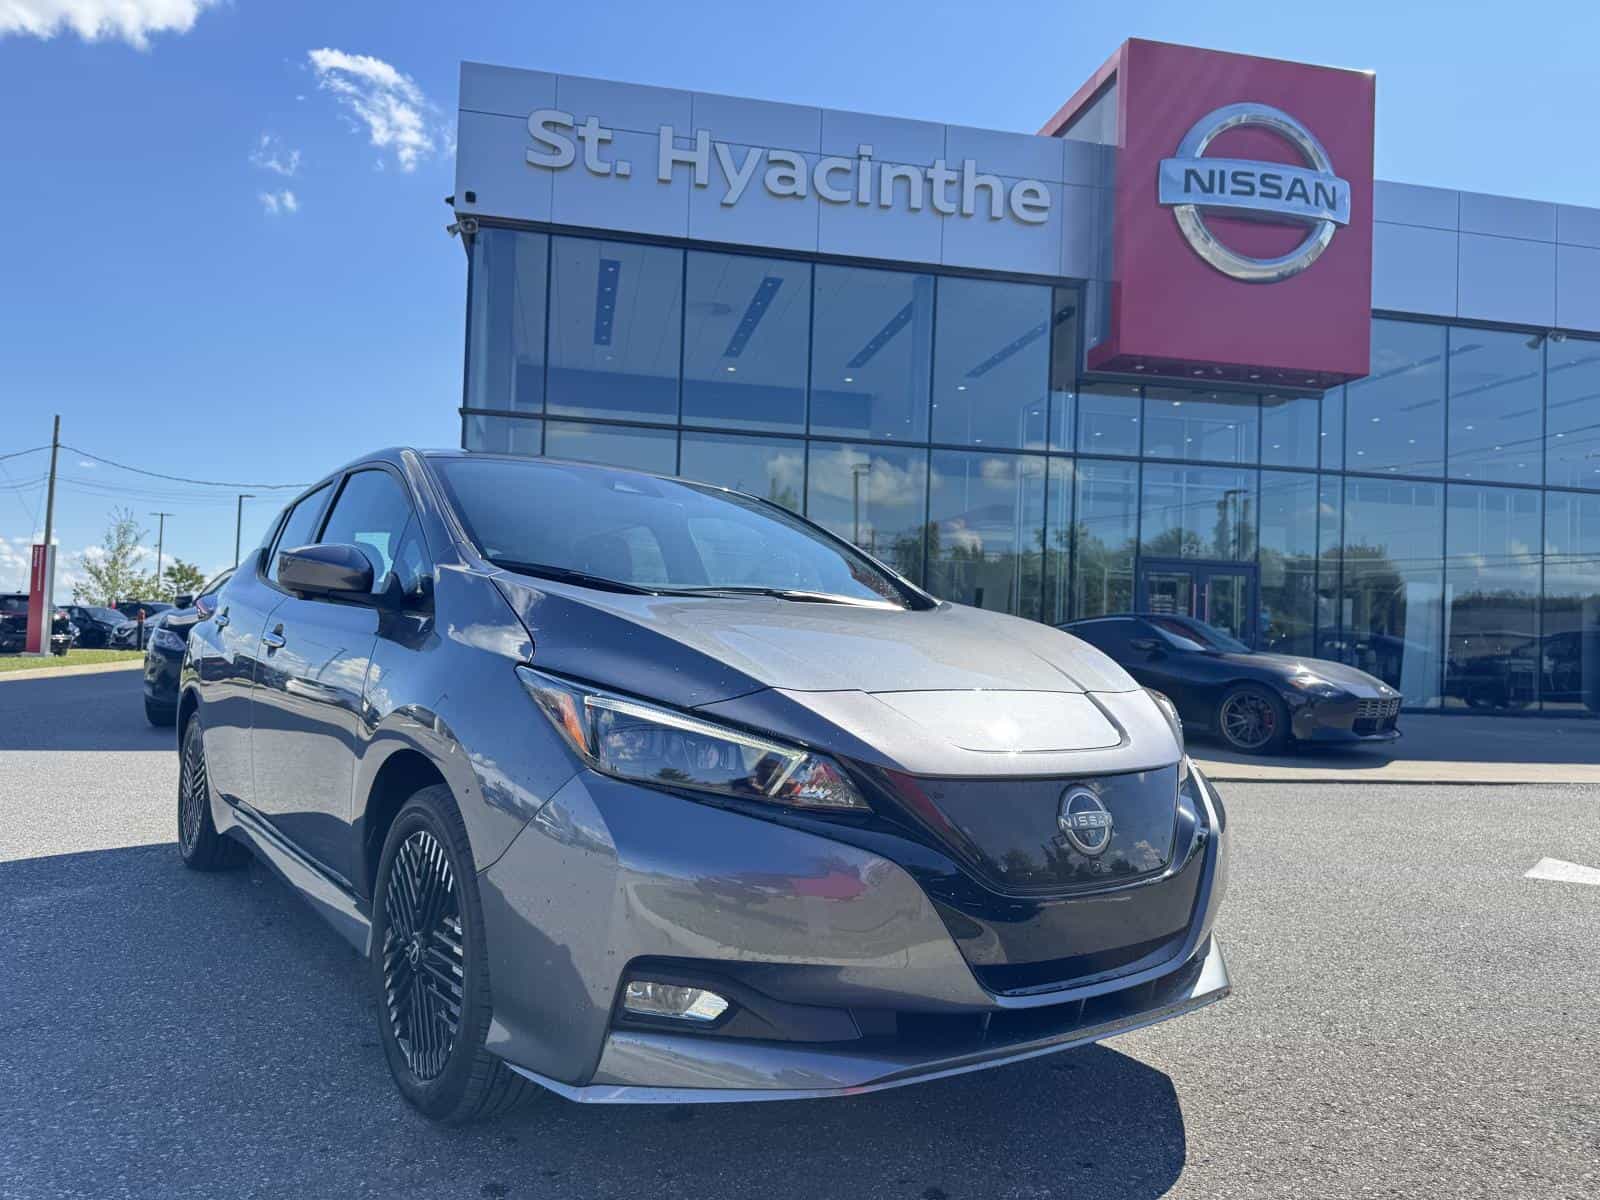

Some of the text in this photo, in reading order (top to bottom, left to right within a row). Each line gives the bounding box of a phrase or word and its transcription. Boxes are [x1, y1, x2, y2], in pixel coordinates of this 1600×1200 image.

[526, 109, 1051, 223] St. Hyacinthe
[1183, 168, 1337, 211] NISSAN
[1059, 815, 1113, 830] NISSAN
